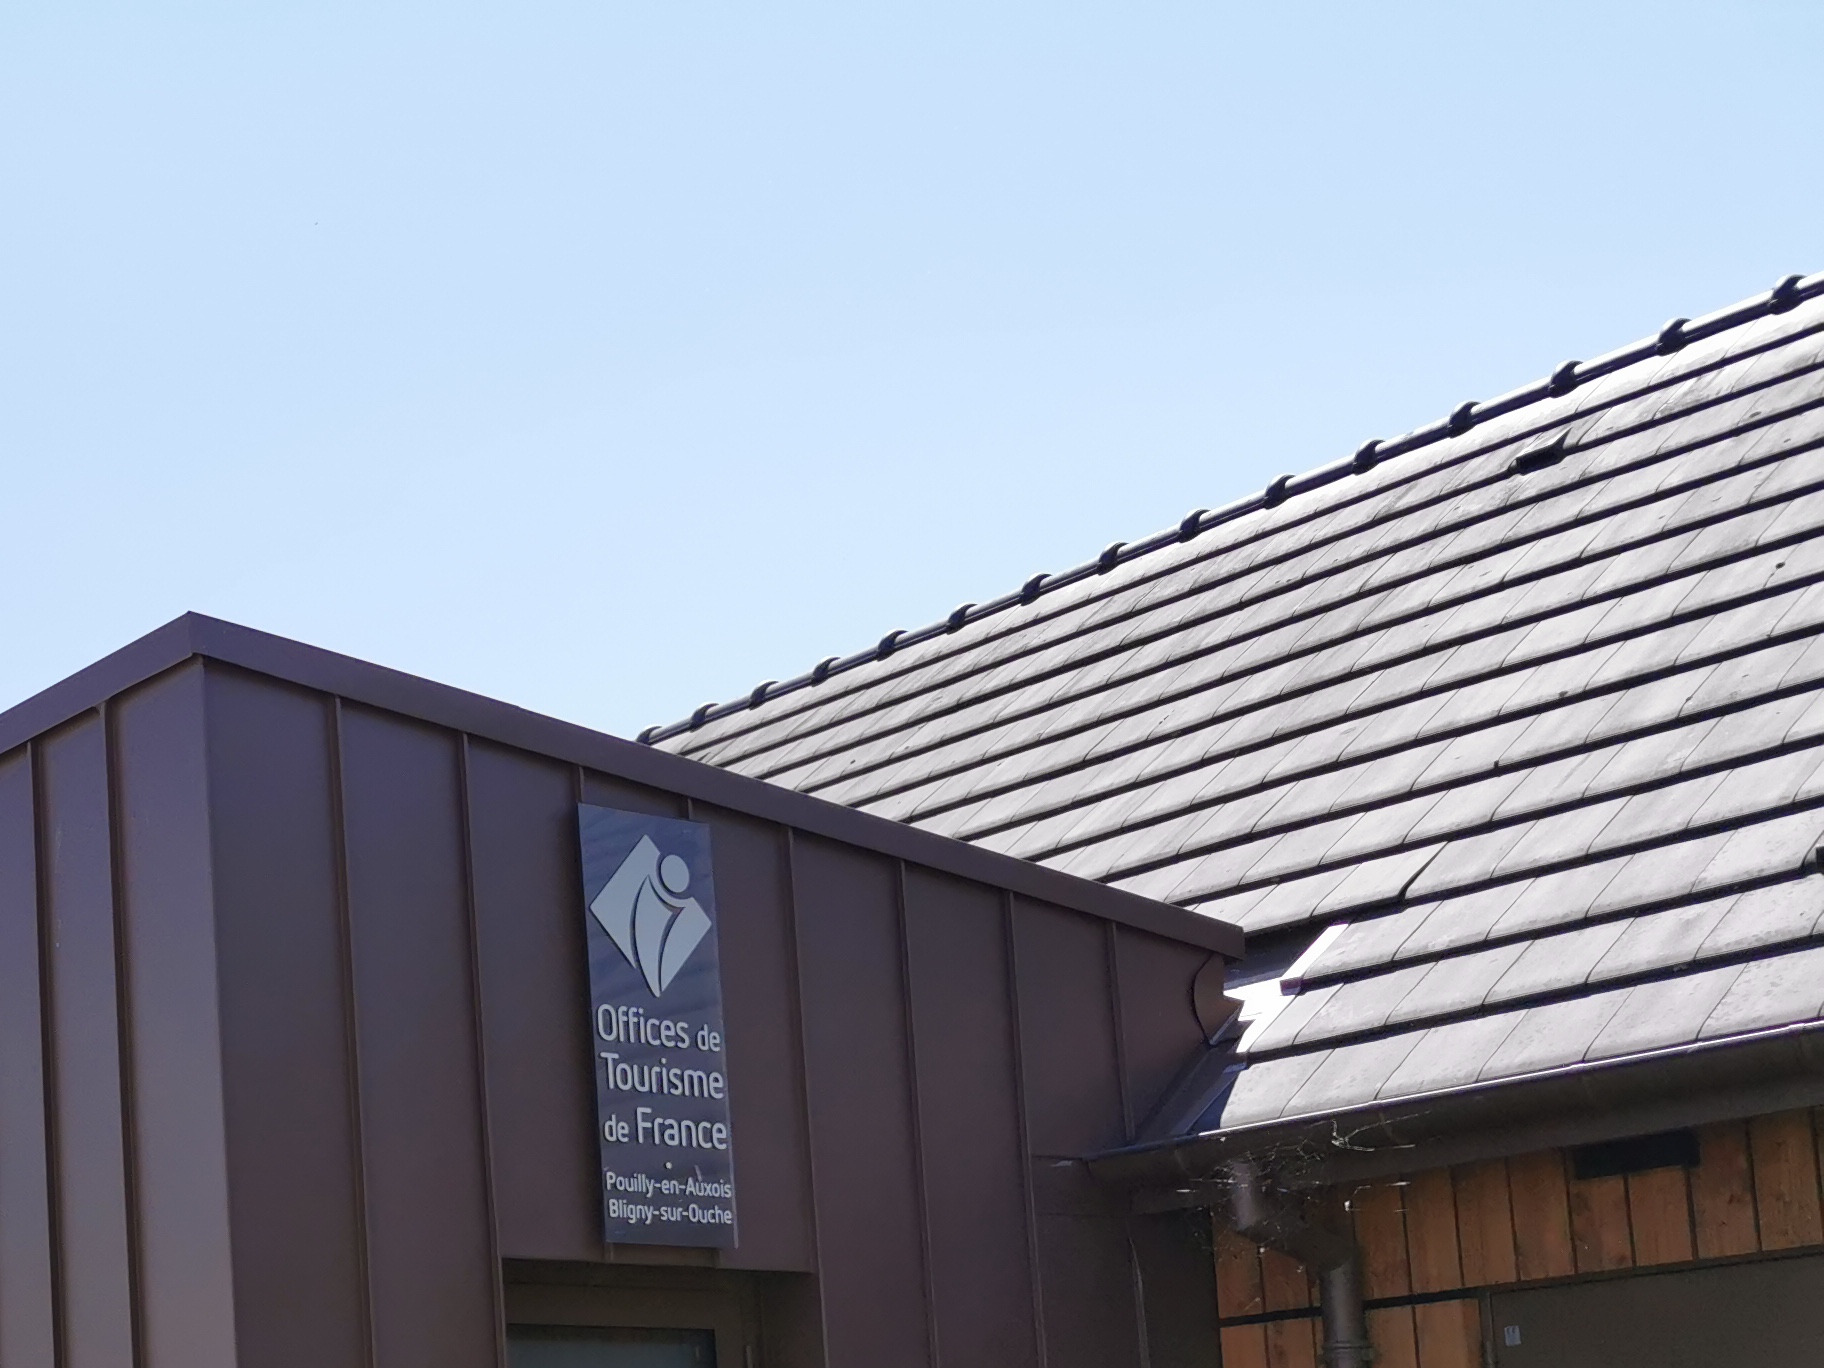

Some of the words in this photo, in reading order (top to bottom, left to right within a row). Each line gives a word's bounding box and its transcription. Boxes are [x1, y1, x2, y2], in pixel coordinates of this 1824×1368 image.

[597, 1003, 690, 1049] Offices
[697, 1023, 721, 1052] de
[600, 1051, 724, 1099] Tourisme
[604, 1114, 629, 1143] de
[636, 1106, 727, 1150] France
[606, 1171, 732, 1198] Pouilly-en-Auxois
[608, 1199, 733, 1225] Bligny-sur-Ouche
